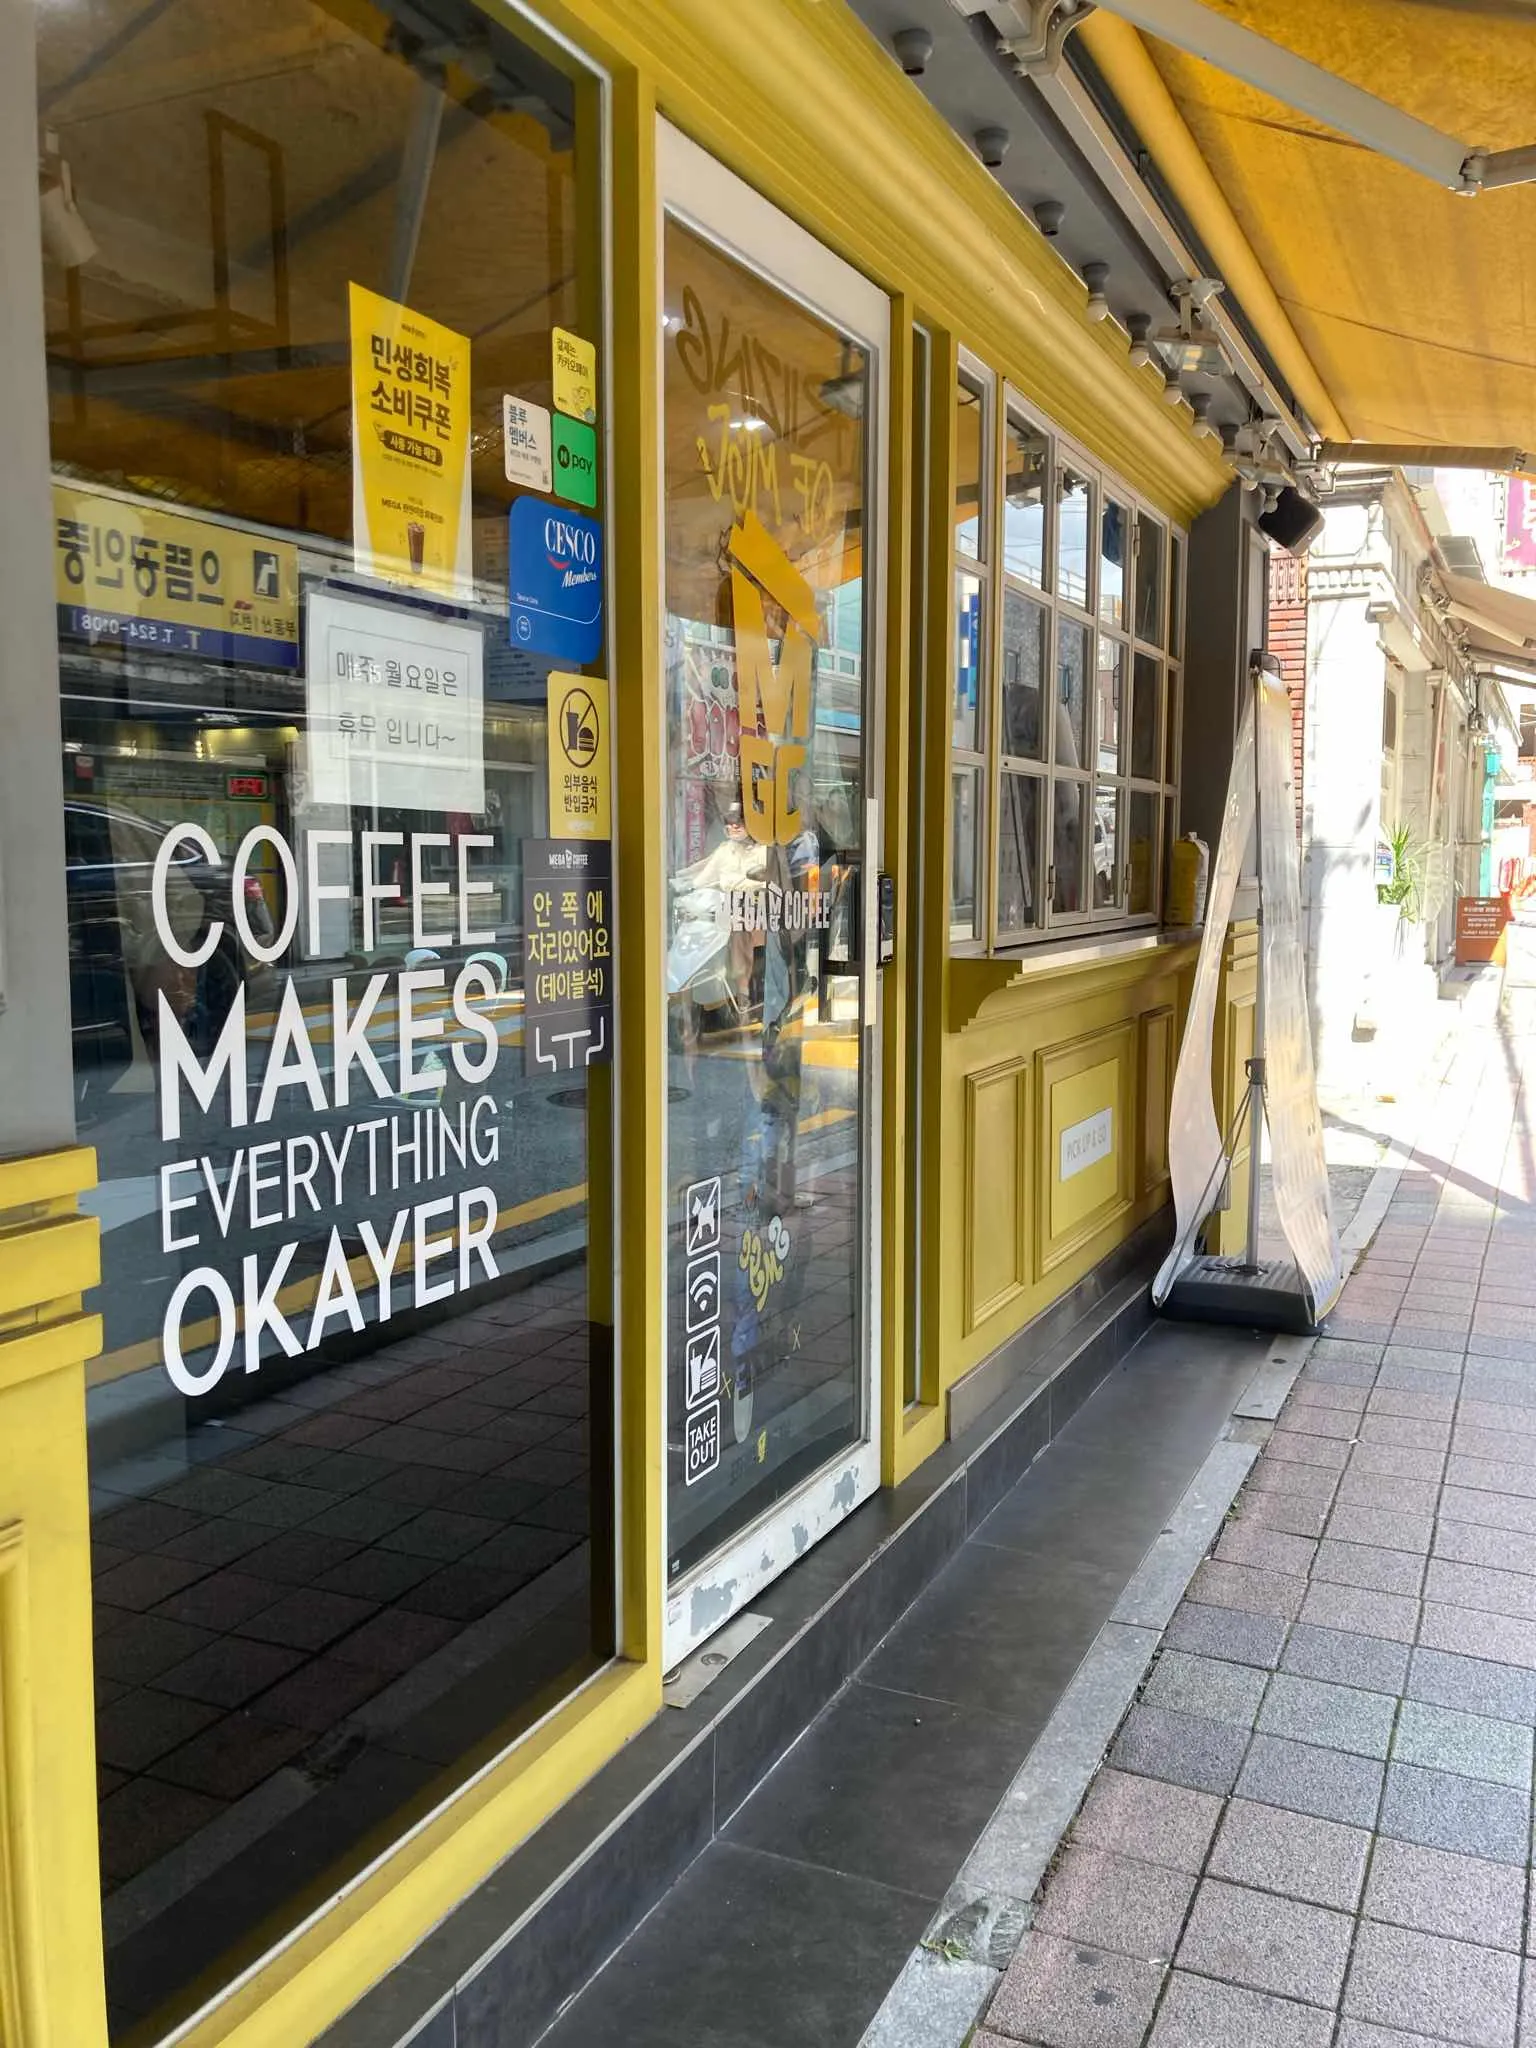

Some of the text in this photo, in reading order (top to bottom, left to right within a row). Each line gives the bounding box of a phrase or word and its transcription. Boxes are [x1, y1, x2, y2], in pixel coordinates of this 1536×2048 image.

[371, 334, 452, 401] 민생회복
[370, 380, 452, 441] 소비쿠폰
[508, 404, 527, 424] 블루
[509, 427, 538, 450] 멤버스
[572, 454, 593, 475] pay
[545, 518, 595, 565] CESCO
[562, 567, 597, 588] Members
[336, 651, 376, 683] 매주
[385, 659, 457, 697] 월요일은
[338, 712, 456, 750] 휴무 입니다~
[563, 774, 598, 794] 외부음식
[564, 794, 598, 815] 반입금지
[152, 822, 497, 968] COFFEE
[784, 890, 831, 930] COFFEE
[527, 927, 610, 966] 자리있어요
[535, 967, 604, 1004] (테이블석)
[157, 962, 500, 1142] MAKES
[161, 1094, 499, 1255] EVERYTHING
[163, 1185, 501, 1397] OKAYER
[690, 1416, 716, 1449] TAKE
[690, 1436, 716, 1470] OUT
